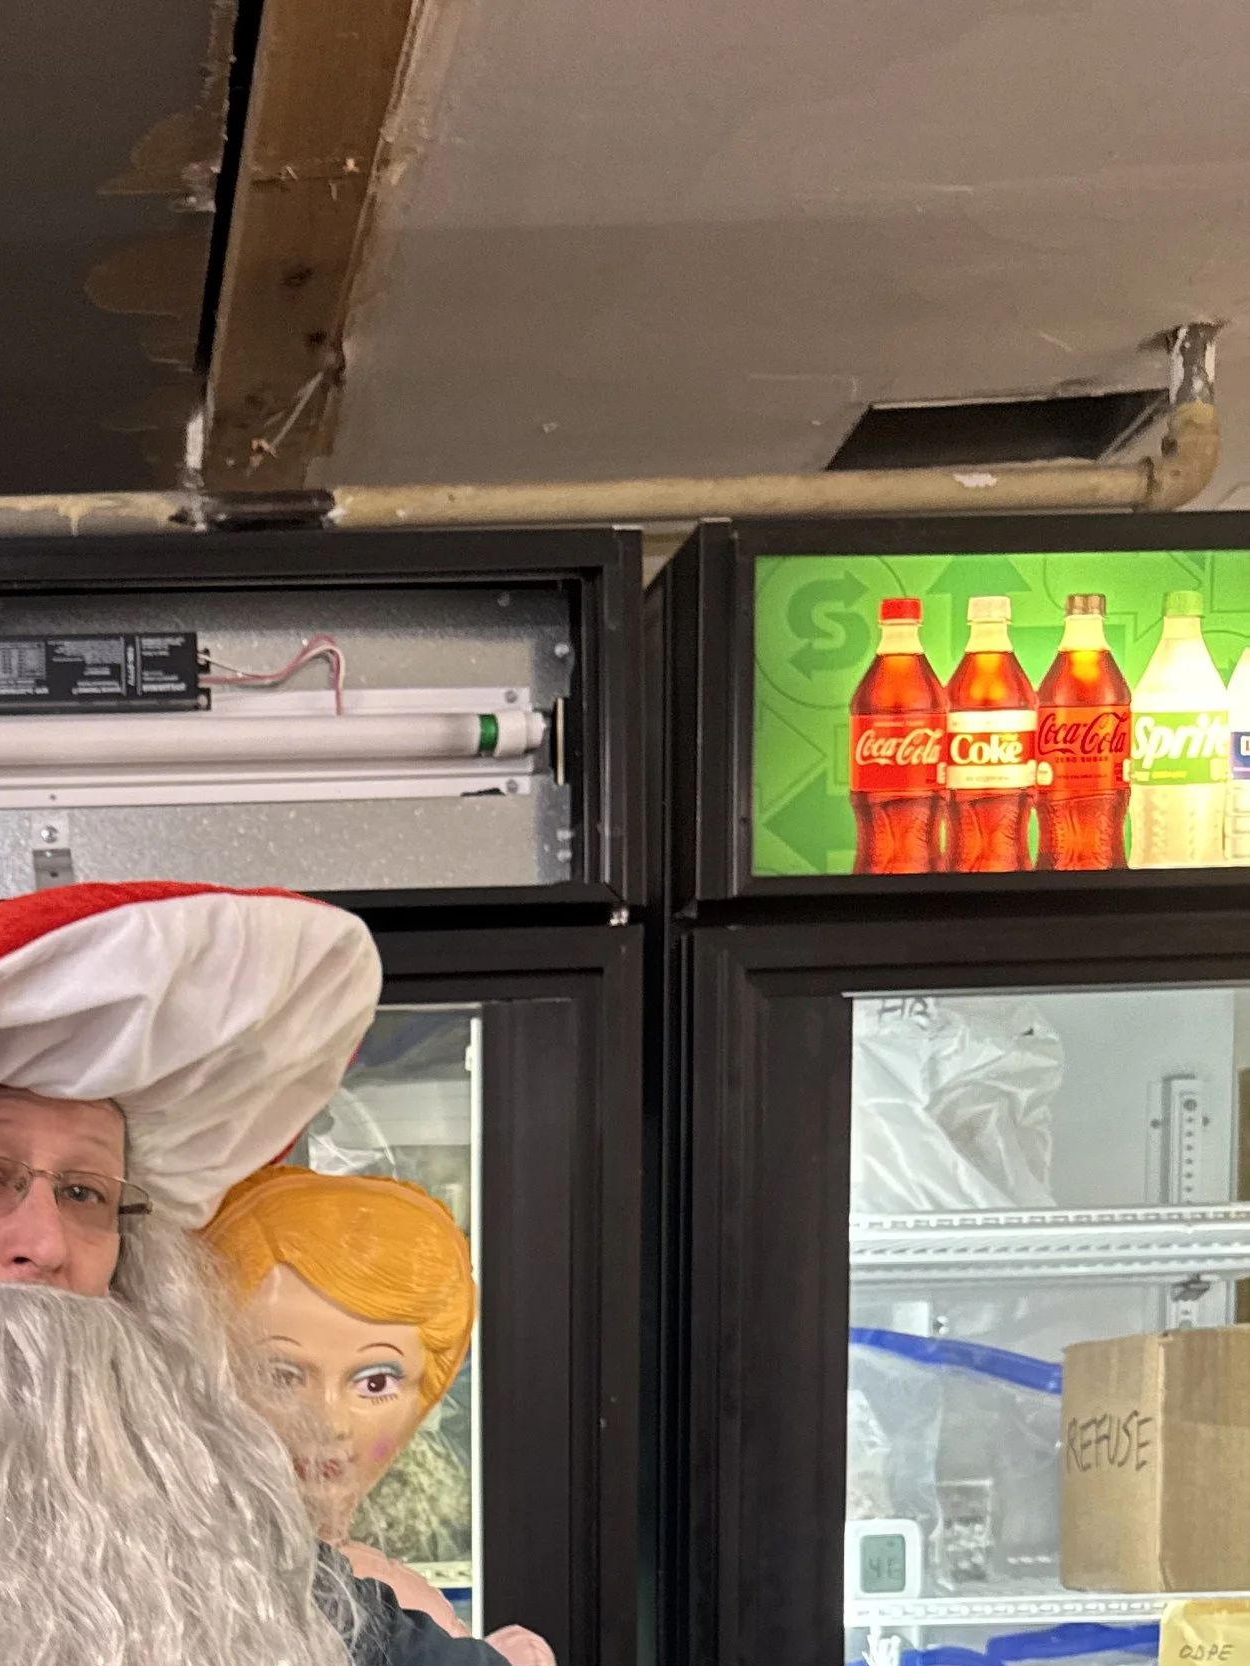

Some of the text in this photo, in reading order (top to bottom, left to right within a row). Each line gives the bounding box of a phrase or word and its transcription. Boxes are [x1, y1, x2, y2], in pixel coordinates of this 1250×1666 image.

[855, 728, 943, 766] Coca-Cola
[950, 733, 1023, 765] Coke
[1037, 712, 1128, 756] Coca-Cola
[1065, 1410, 1155, 1473] REFUSE
